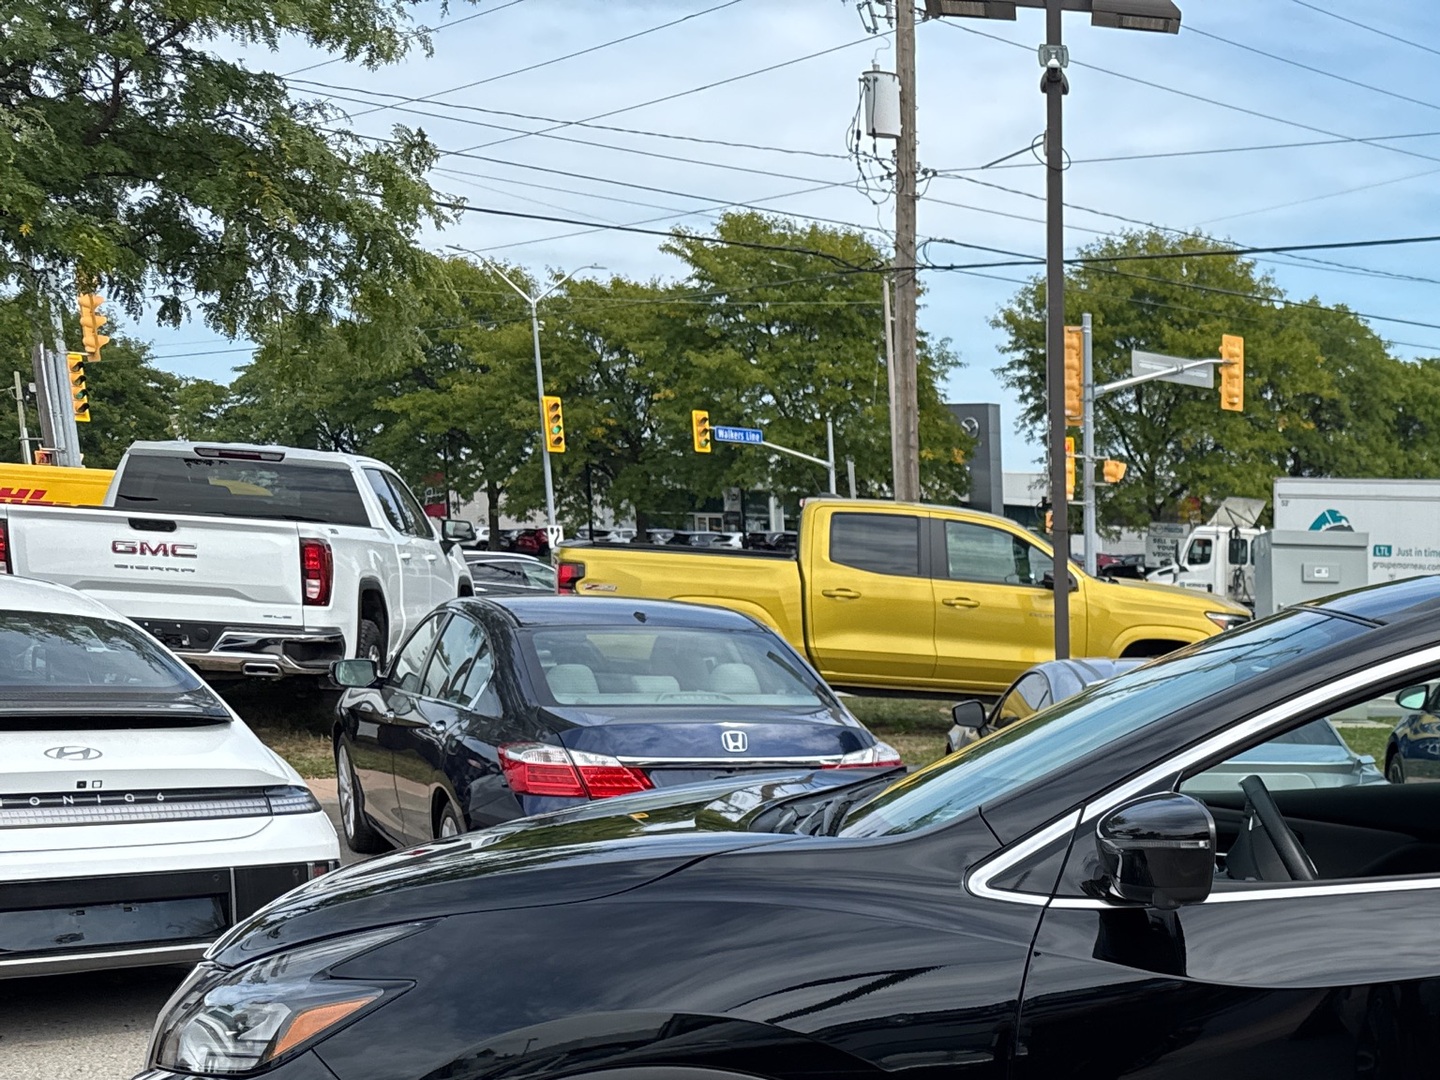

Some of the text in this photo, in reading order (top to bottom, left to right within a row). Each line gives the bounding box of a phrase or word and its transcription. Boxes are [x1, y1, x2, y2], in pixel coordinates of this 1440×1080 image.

[718, 429, 760, 442] Walkers Line
[112, 540, 198, 559] GMC
[1375, 545, 1390, 556] LTL
[1396, 547, 1413, 557] Just
[1414, 546, 1423, 557] in
[114, 564, 196, 573] SIERRA
[156, 792, 166, 802] 6
